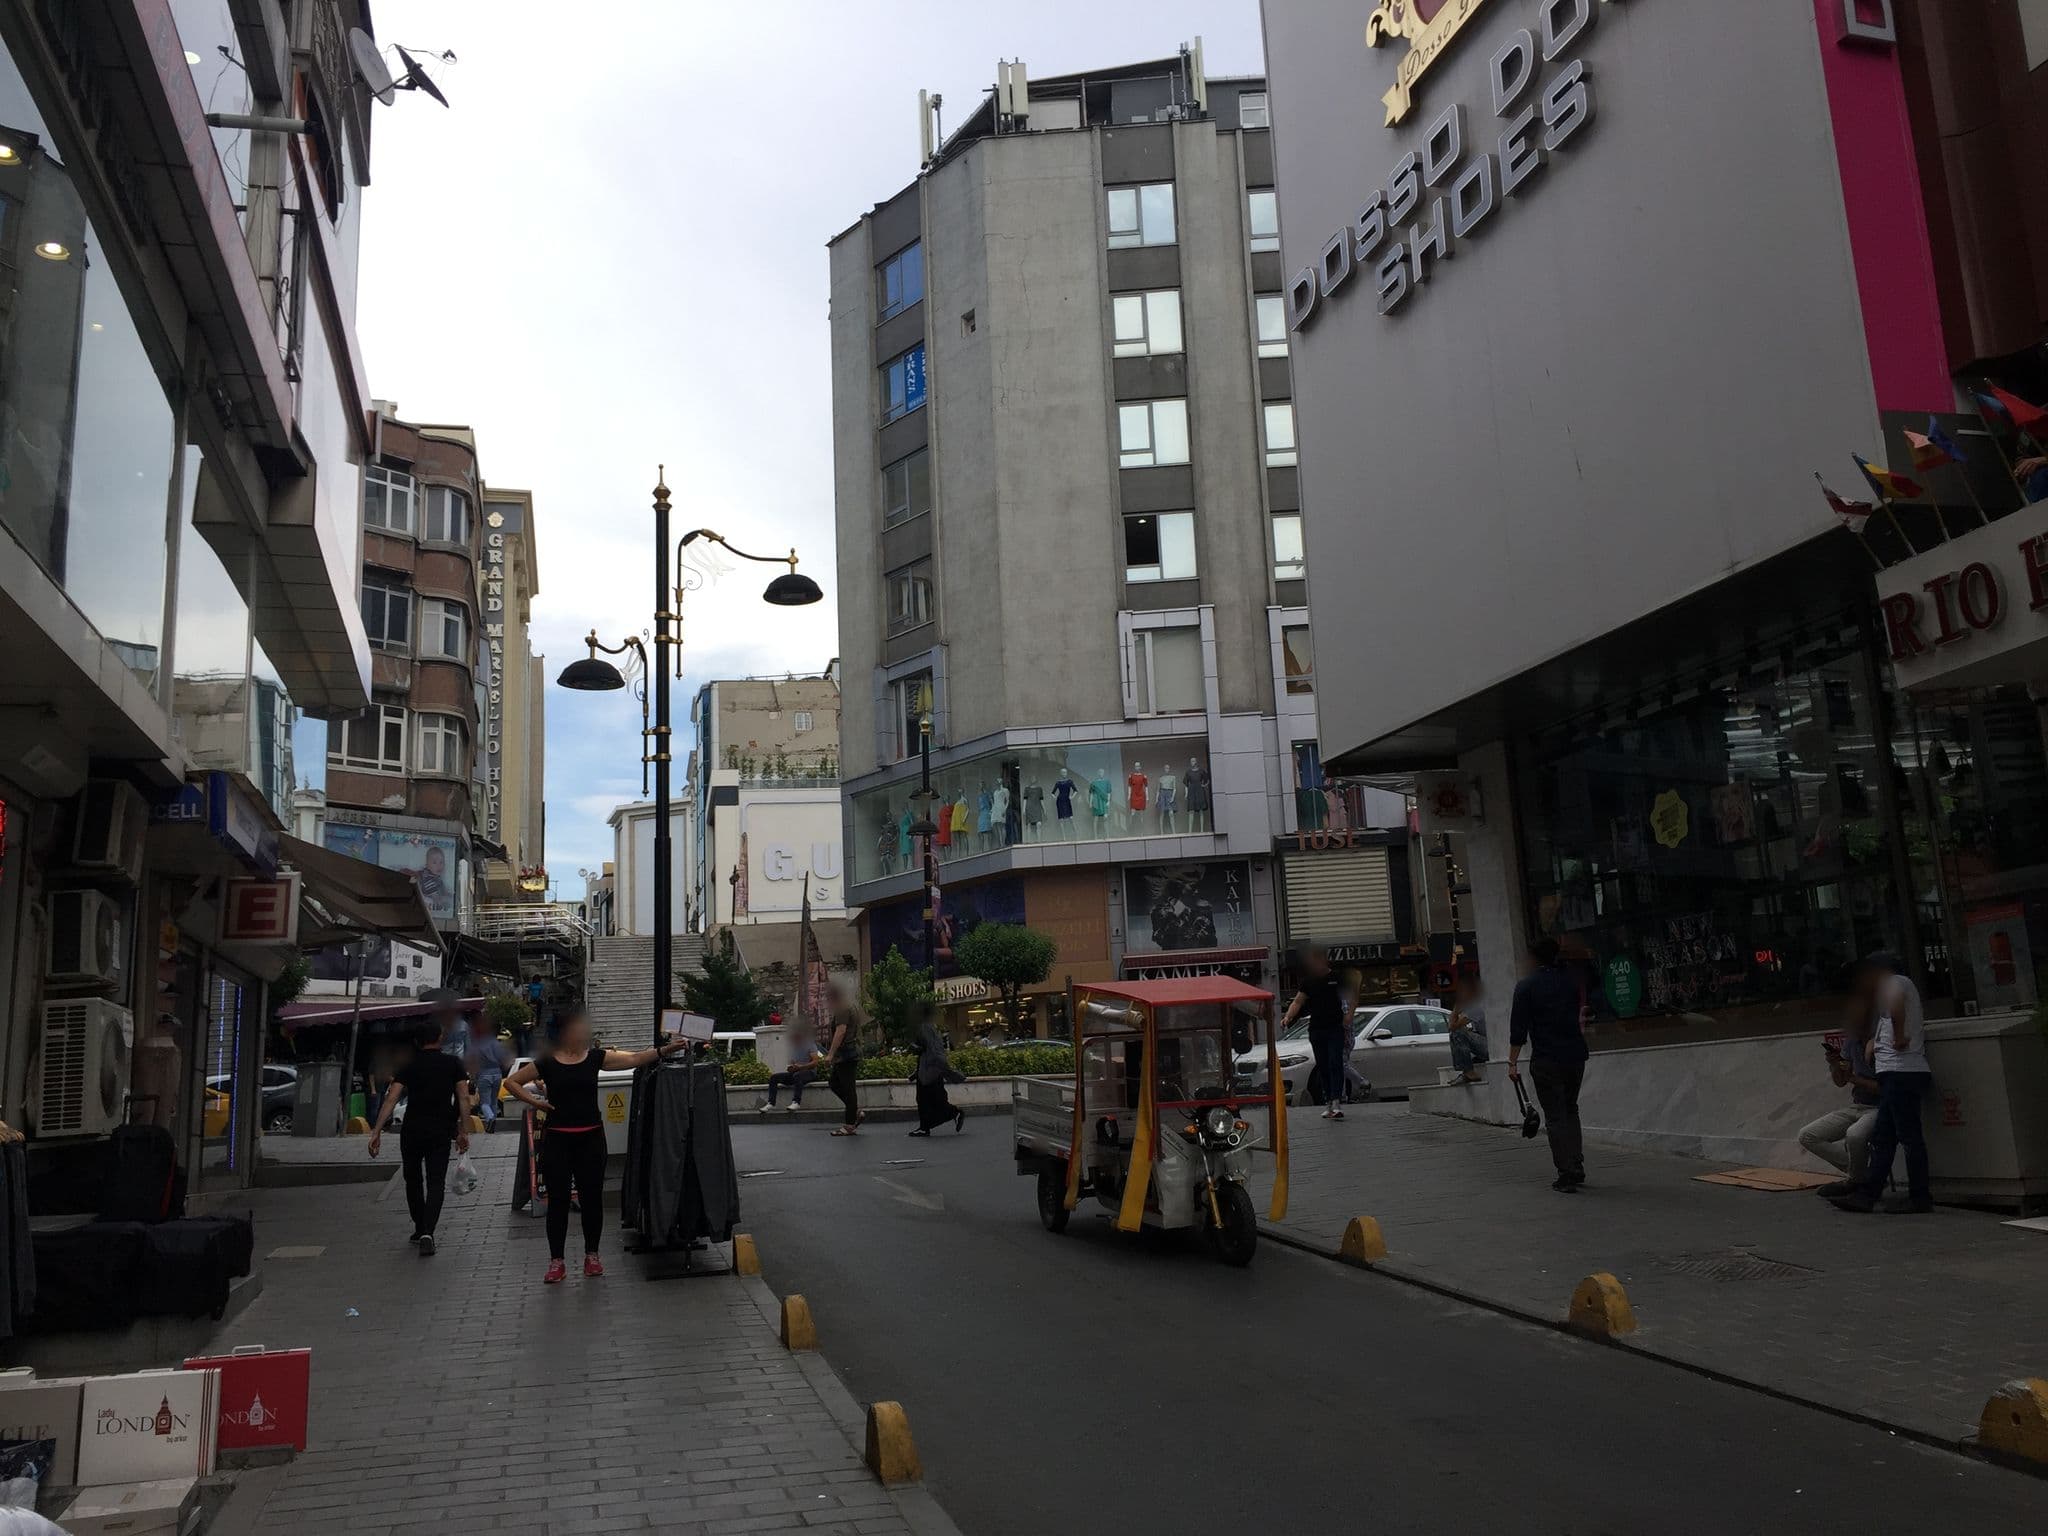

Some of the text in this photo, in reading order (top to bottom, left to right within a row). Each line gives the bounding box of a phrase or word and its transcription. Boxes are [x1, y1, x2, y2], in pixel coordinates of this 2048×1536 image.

[1287, 0, 1608, 331] DOSSO DO
[1375, 59, 1589, 315] SHOES
[1880, 562, 1999, 661] RIO
[487, 533, 504, 843] GRAND MARCELLO HOTE
[238, 888, 277, 931] E
[1224, 869, 1242, 946] KAMER
[949, 980, 987, 1000] SHOES
[1609, 960, 1631, 975] %40
